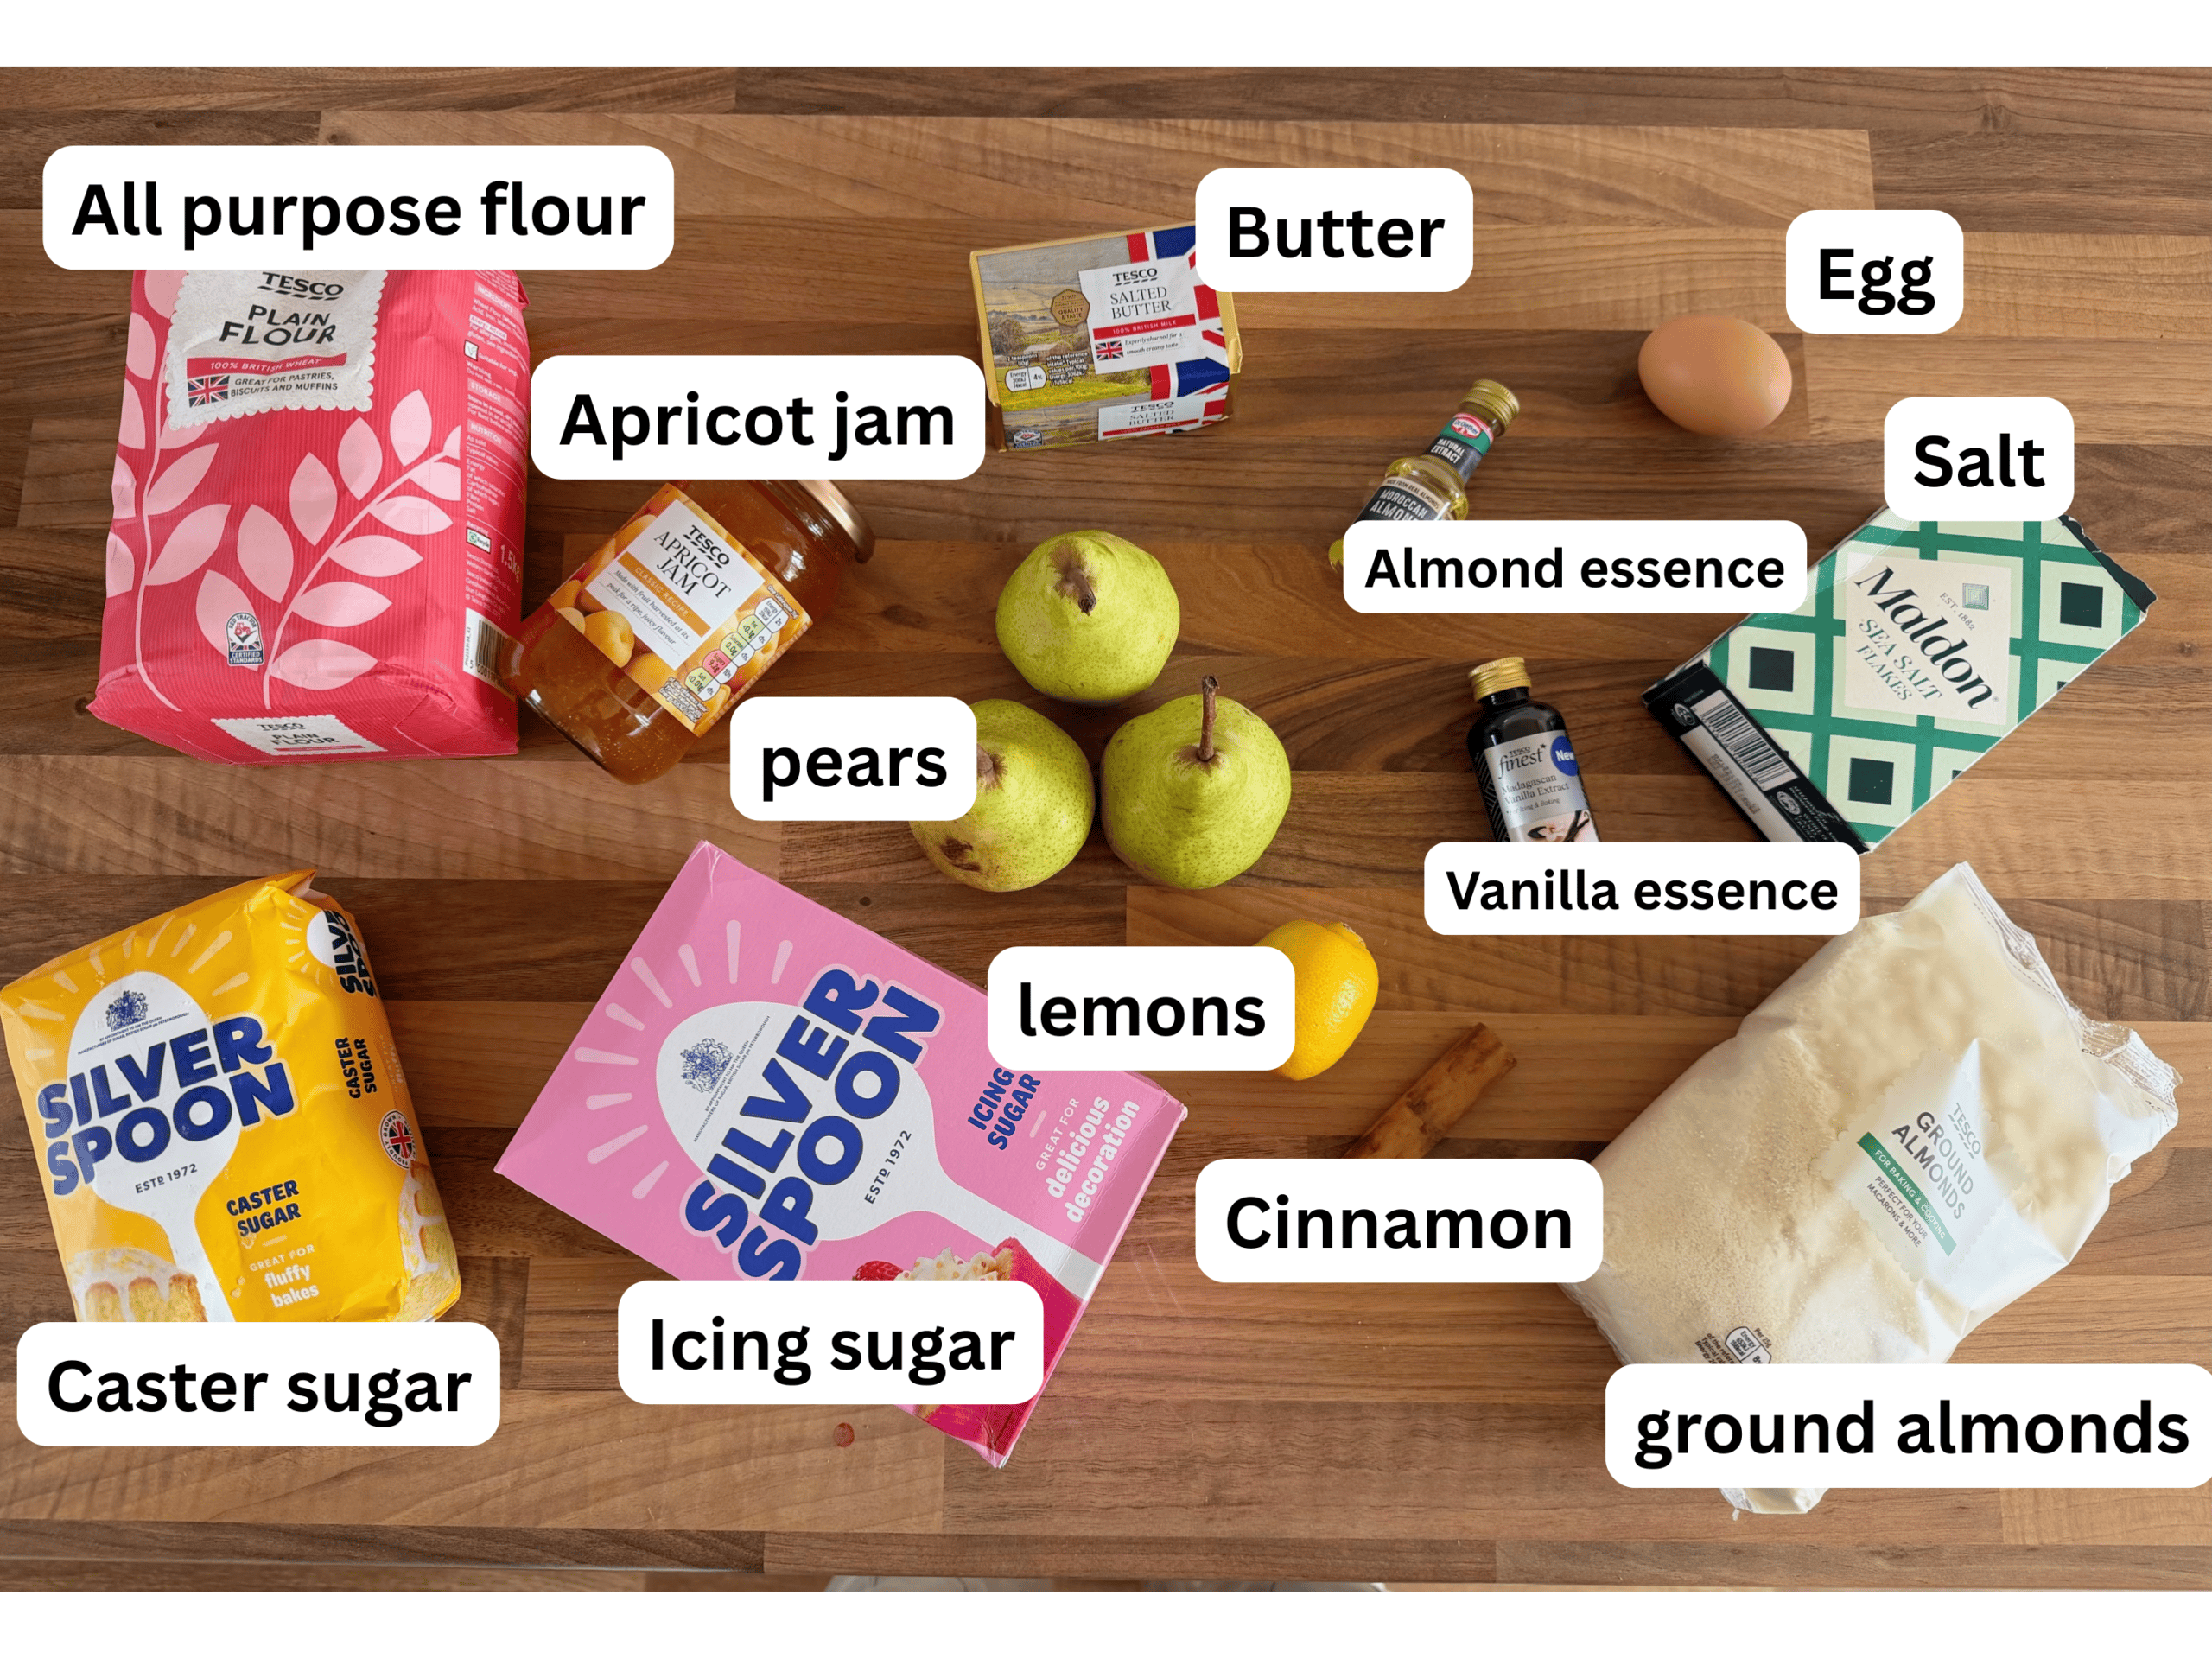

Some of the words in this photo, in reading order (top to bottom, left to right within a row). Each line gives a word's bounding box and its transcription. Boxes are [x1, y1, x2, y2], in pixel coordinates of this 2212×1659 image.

[262, 271, 345, 296] TESCO
[1112, 268, 1158, 283] TESCO
[1110, 286, 1167, 305] SALTED
[1111, 300, 1171, 319] BUTTER
[248, 304, 330, 326] PLAIN
[219, 321, 336, 346] FLOUR
[1147, 333, 1168, 342] churned
[1146, 345, 1165, 353] creamy
[234, 378, 267, 386] GREAT
[288, 372, 334, 382] PASTRIES,
[241, 363, 283, 372] BRITISH
[285, 358, 321, 369] WHEAT
[231, 385, 270, 397] BISCUITS
[471, 381, 500, 402] STORAGE
[1129, 416, 1173, 426] BUTTER
[1130, 410, 1173, 420] SALTED
[1131, 402, 1174, 412] TESCO
[471, 423, 502, 444] NUTRITION
[1437, 438, 1465, 456] NATURAL
[1430, 445, 1461, 464] EXTRACT
[1380, 489, 1428, 518] MOROCCAN
[1408, 485, 1420, 493] REAL
[1420, 489, 1440, 510] ALMONDS
[689, 524, 730, 566] TESCO
[653, 531, 732, 598] APRICOT
[657, 557, 699, 596] JAM
[614, 570, 628, 583] Made
[626, 581, 639, 593] with
[637, 590, 651, 604] fruit
[650, 601, 677, 627] harvested
[635, 567, 664, 593] CLASSIC
[663, 592, 689, 617] RECIPE
[237, 614, 257, 628] TRACTOR
[606, 582, 620, 594] peak
[618, 592, 628, 601] for
[630, 603, 643, 616] ripe,
[642, 613, 656, 627] juicy
[653, 626, 677, 645] flavour
[1939, 592, 1959, 613] EST.
[1958, 612, 1975, 632] 1882
[725, 641, 738, 656] 0.0g
[1853, 564, 1993, 709] Maldon
[708, 659, 721, 673] 9.2g
[713, 653, 726, 666] Sugars
[1856, 645, 1913, 701] FLAKES
[1859, 619, 1897, 657] SEA
[1893, 655, 1942, 700] SALT
[257, 722, 305, 731] TESCO
[1498, 749, 1543, 779] finest
[1509, 747, 1530, 755] TESCO
[1501, 775, 1557, 795] Madagascan
[1504, 790, 1535, 804] Vanilla
[1537, 782, 1569, 797] Extract
[1540, 798, 1560, 807] Baking
[158, 1011, 189, 1025] PETERBOROUGH
[38, 1016, 273, 1139] SILVER
[335, 1037, 361, 1099] CASTER
[353, 1038, 378, 1094] SUGAR
[694, 1106, 716, 1142] MANUFACTURERS
[728, 1068, 738, 1086] BRITISH
[737, 1054, 747, 1070] SUGAR
[749, 1015, 771, 1050] PETERBOROUGH
[709, 1077, 727, 1107] APPOINTMENT
[739, 1039, 749, 1056] QUEEN
[685, 969, 880, 1249] SILVER
[968, 1067, 1015, 1131] ICING
[988, 1073, 1042, 1151] SUGAR
[47, 1062, 295, 1196] SPOON
[738, 985, 940, 1281] SPOON
[1035, 1127, 1063, 1171] GREAT
[1059, 1097, 1080, 1126] FOR
[1953, 1103, 1981, 1155] TESCO
[886, 1129, 912, 1166] 1972
[1046, 1096, 1110, 1198] delicious
[1065, 1100, 1141, 1223] decoration
[1916, 1111, 1974, 1195] GROUND
[167, 1163, 198, 1181] 1972
[1891, 1124, 1966, 1220] ALMONDS
[226, 1179, 299, 1217] CASTER
[1874, 1176, 1903, 1207] PERFECT
[1899, 1205, 1913, 1222] FOR
[1910, 1217, 1928, 1240] YOUR
[1875, 1149, 1891, 1169] FOR
[1890, 1166, 1916, 1198] BAKING
[1921, 1203, 1946, 1240] COOKING
[237, 1203, 302, 1237] SUGAR
[1867, 1183, 1901, 1223] MACARONS
[1899, 1219, 1904, 1228] &
[1903, 1225, 1922, 1248] MORE
[249, 1253, 286, 1272] GREAT
[289, 1243, 315, 1260] FOR
[264, 1263, 311, 1288] fluffy
[270, 1284, 320, 1308] bakes
[1740, 1331, 1757, 1349] Energy
[1754, 1327, 1764, 1338] Per
